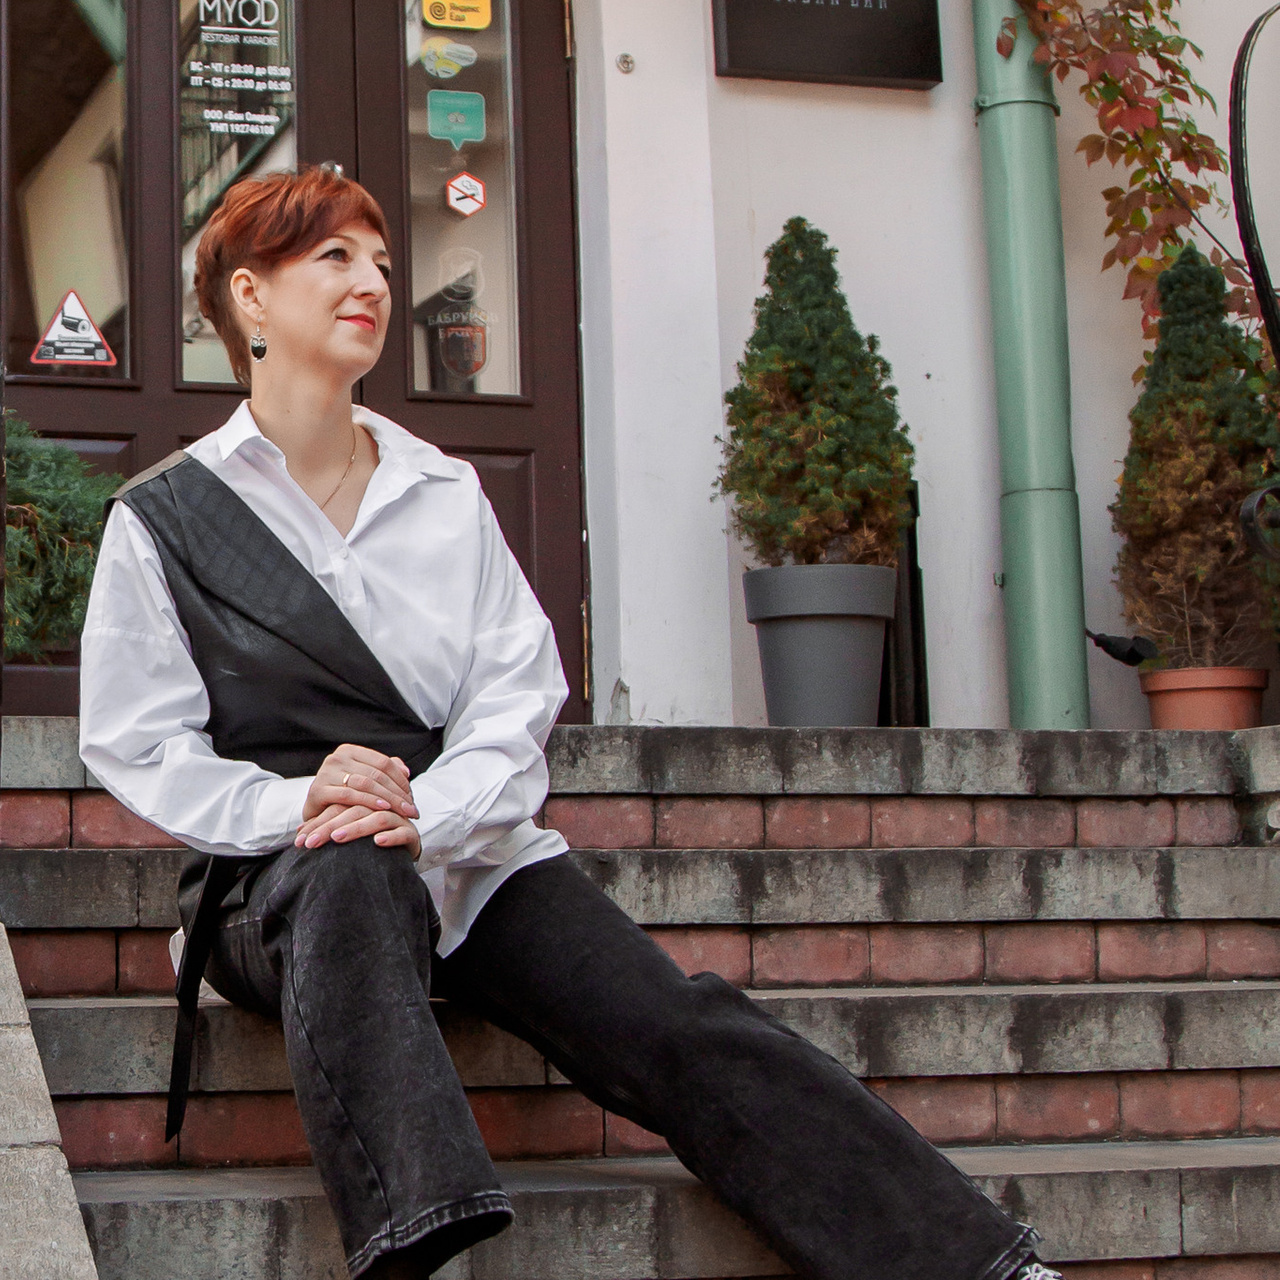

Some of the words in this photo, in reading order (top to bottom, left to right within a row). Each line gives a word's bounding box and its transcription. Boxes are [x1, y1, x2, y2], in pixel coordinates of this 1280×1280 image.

[201, 32, 240, 44] RESTOBAR
[242, 35, 279, 47] KARAOKE
[211, 62, 223, 73] ЧТ
[255, 67, 266, 77] до
[190, 76, 204, 87] ПТ
[211, 77, 223, 87] СБ
[255, 81, 267, 91] до
[203, 109, 223, 120] ООО
[210, 122, 229, 133] УНП
